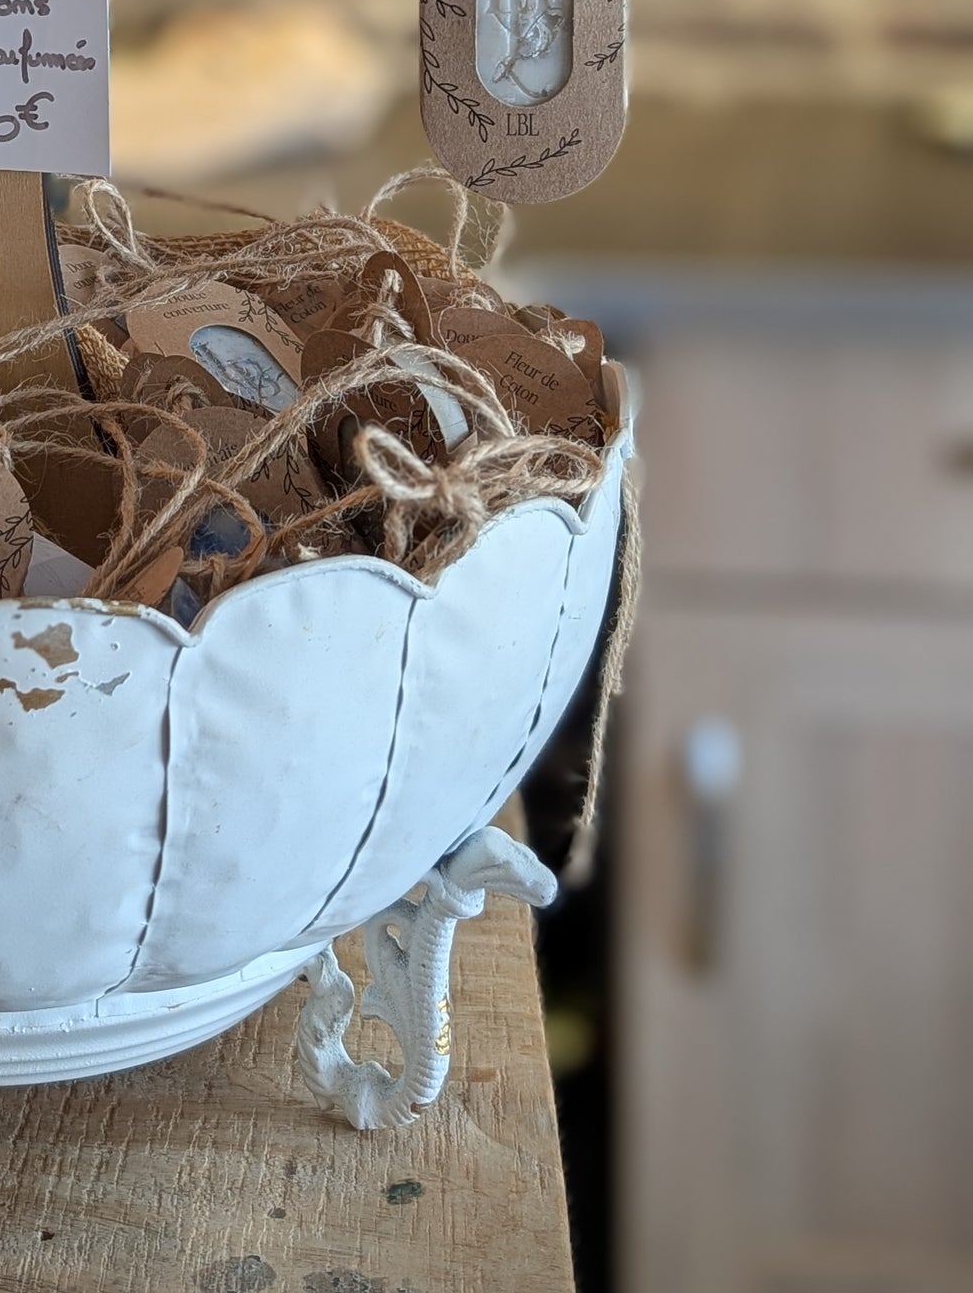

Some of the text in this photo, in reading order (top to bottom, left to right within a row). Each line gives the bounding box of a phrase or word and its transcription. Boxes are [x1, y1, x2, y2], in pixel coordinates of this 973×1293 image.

[505, 112, 540, 137] LBL
[163, 303, 230, 319] couverture
[504, 351, 560, 391] Fleur de
[499, 374, 539, 405] Coton
